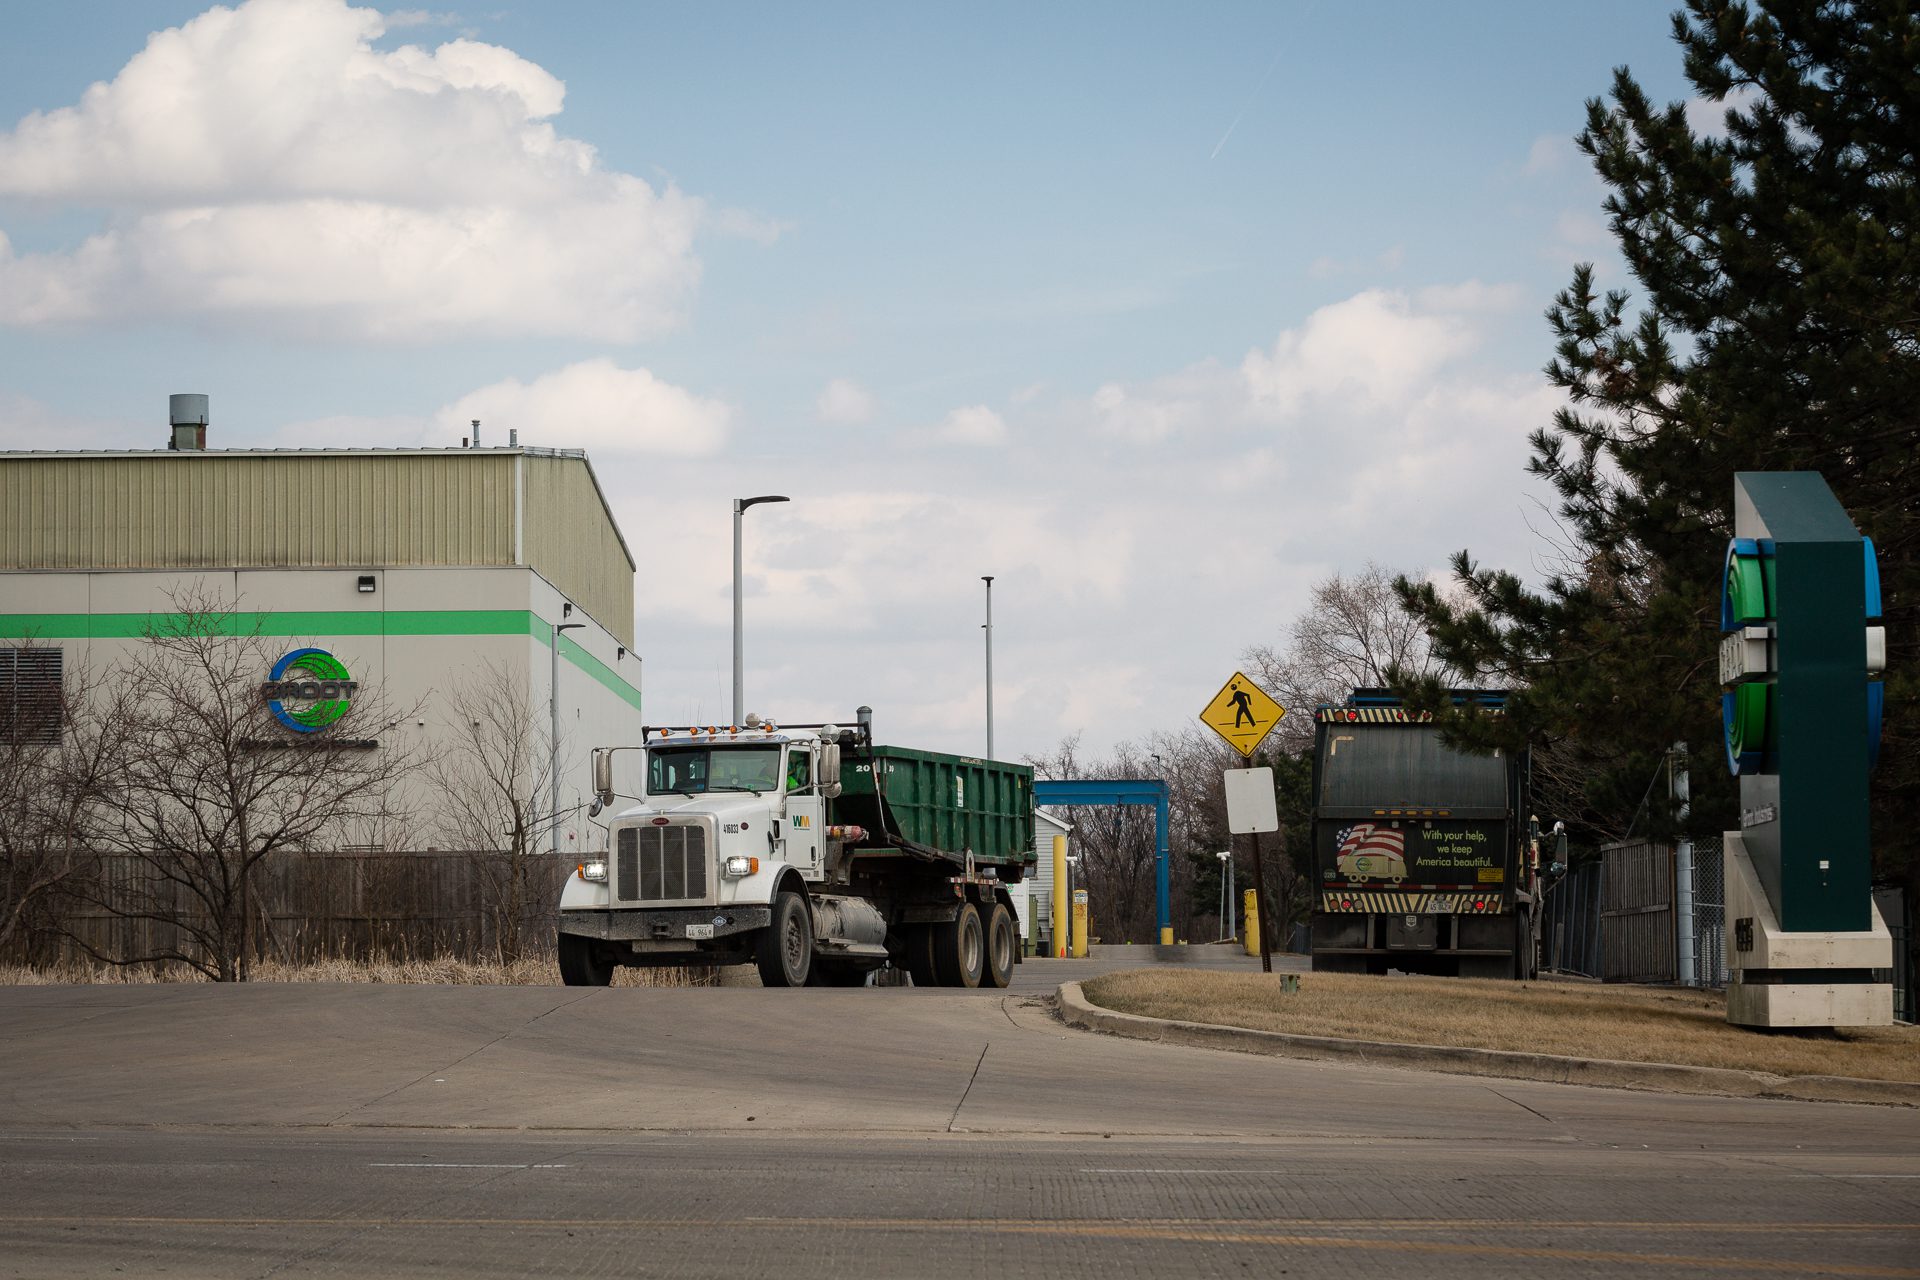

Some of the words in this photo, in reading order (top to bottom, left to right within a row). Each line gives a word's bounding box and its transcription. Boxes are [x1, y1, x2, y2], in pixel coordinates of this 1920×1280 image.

[855, 764, 871, 772] 20
[793, 815, 811, 827] WM
[1422, 830, 1443, 840] With
[1444, 832, 1464, 842] your
[1465, 830, 1487, 842] help,
[1452, 843, 1472, 855] keep
[1416, 856, 1451, 866] America
[1454, 856, 1493, 867] beautiful.
